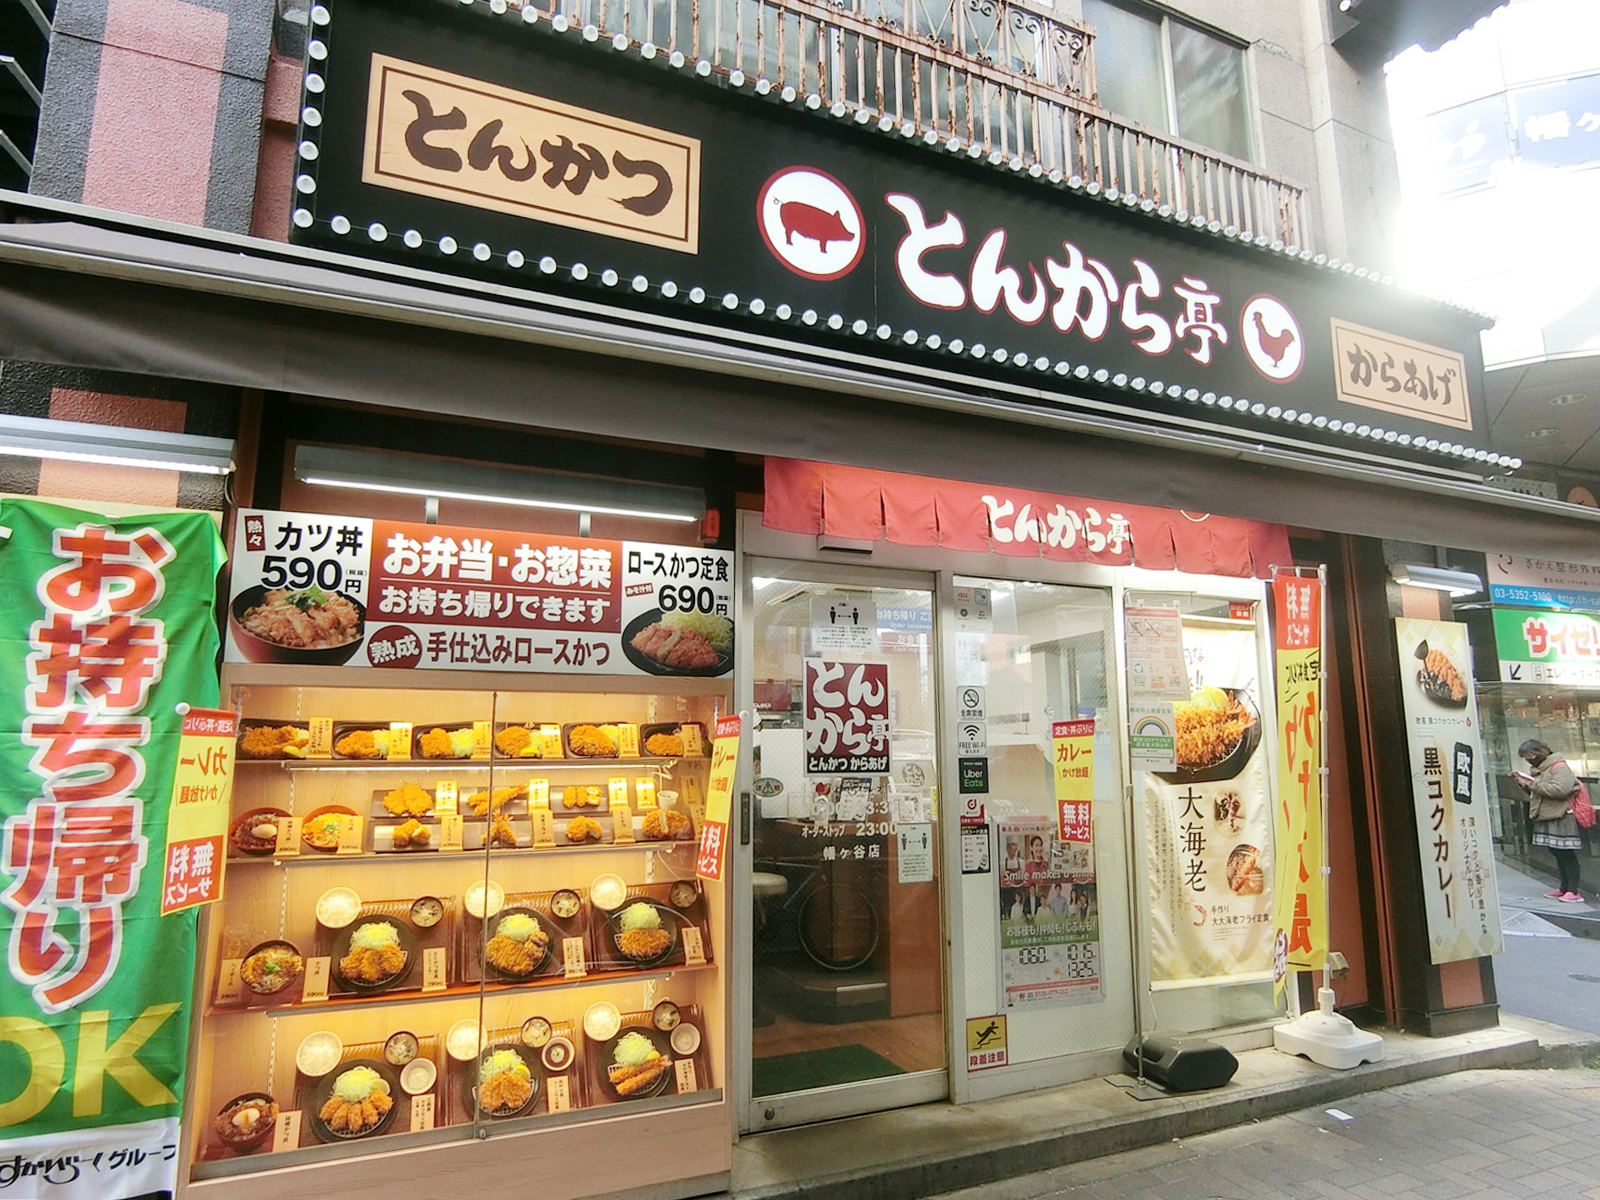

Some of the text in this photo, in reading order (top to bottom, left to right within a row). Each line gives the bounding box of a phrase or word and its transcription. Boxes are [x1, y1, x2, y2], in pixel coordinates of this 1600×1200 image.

[402, 89, 673, 216] とんかつ
[884, 191, 1230, 367] とんから亭
[1346, 341, 1458, 406] からあげ
[274, 521, 364, 557] カツ丼
[980, 494, 1132, 555] とんから亭
[382, 532, 612, 589] お弁当・お惣菜
[628, 551, 729, 583] ロースかつ定食
[378, 585, 611, 624] お持ち帰りできます
[427, 630, 611, 667] 手仕込みロースかつ
[808, 660, 885, 708] とん
[806, 706, 890, 756] から亭
[1055, 724, 1093, 736] 定食・丼ぶりに
[3, 523, 178, 1015] お持ち帰り
[809, 756, 888, 771] とんかつ からあげ
[1057, 743, 1092, 763] カレー
[963, 769, 984, 778] Uber
[964, 779, 984, 787] Eats
[1062, 766, 1089, 778] かけ放題
[1456, 751, 1472, 797] 欧風
[802, 823, 898, 839] オーダーストップ 23:00
[1062, 803, 1090, 826] 無料
[1063, 824, 1090, 840] サービス
[1178, 786, 1208, 893] 大海老
[1423, 747, 1454, 919] 黒コクカレー
[1004, 870, 1030, 881] Smile
[1460, 818, 1475, 909] オリジナルカレー
[1468, 816, 1488, 935] 深いコクと香り豊かな
[1211, 904, 1230, 914] 手作り
[1211, 913, 1270, 926] 大大海老フライ定食
[970, 1051, 1005, 1066] 段差注意
